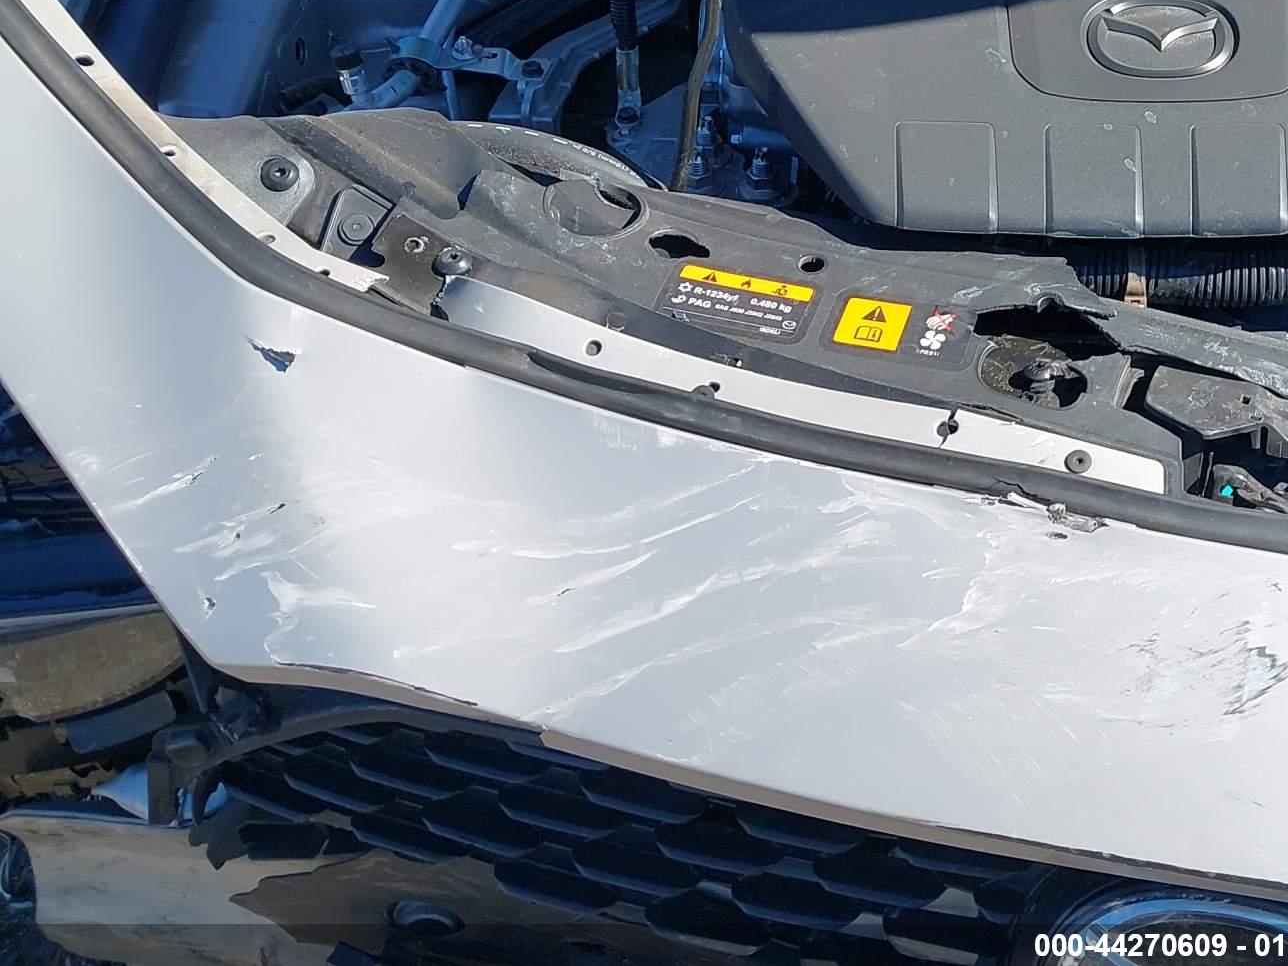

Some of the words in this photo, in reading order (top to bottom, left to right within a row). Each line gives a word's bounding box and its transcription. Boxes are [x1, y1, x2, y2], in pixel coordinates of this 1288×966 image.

[688, 297, 712, 308] PAG
[693, 286, 740, 302] R-1234yf
[750, 298, 778, 309] 0.480
[778, 303, 793, 313] kg
